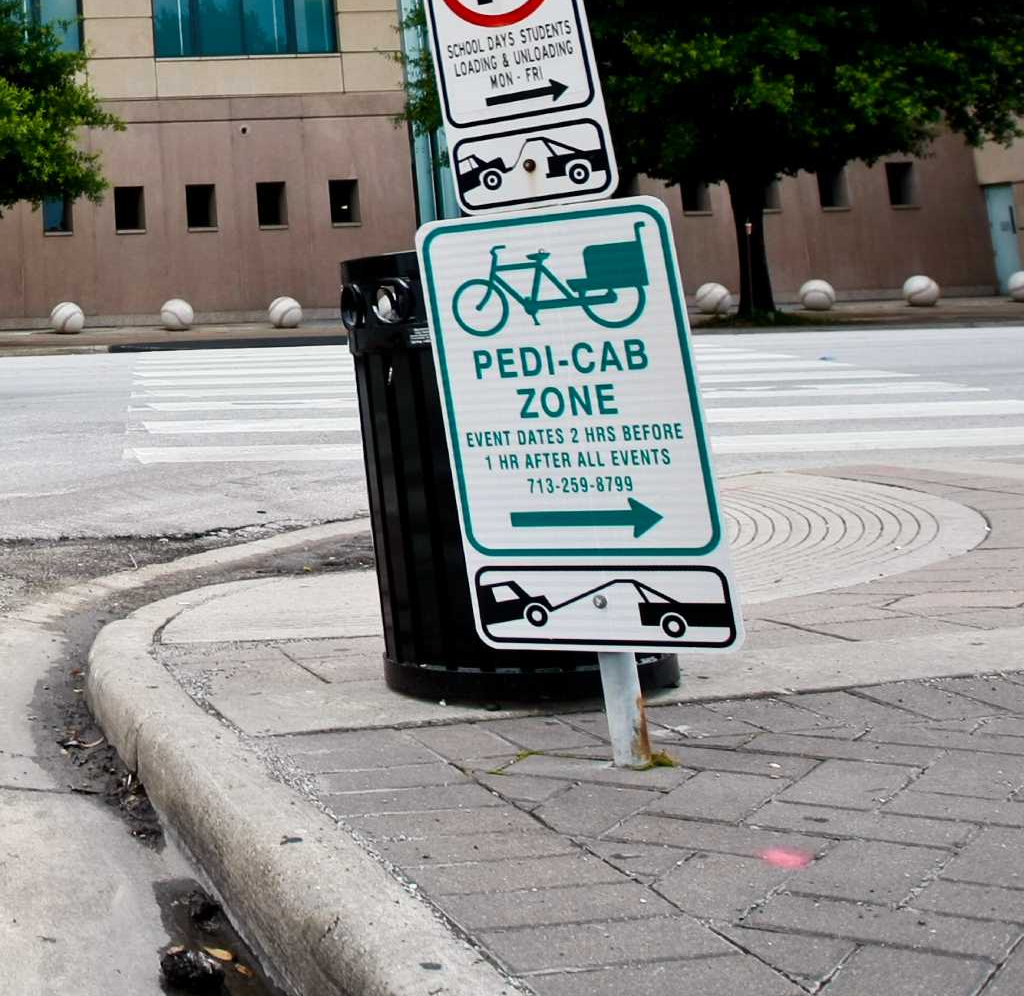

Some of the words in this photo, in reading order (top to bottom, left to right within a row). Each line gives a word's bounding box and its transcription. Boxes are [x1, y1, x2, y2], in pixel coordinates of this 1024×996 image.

[447, 39, 484, 59] SCHOOL
[487, 31, 515, 50] DAYS
[520, 20, 572, 44] STUDENTS
[455, 54, 497, 77] LOADING
[502, 49, 510, 68] &
[514, 40, 574, 65] UNLOADING
[490, 69, 514, 89] MON
[525, 65, 543, 83] FRI
[473, 338, 649, 380] PEDI-CAB
[516, 383, 619, 419] ZONE
[466, 431, 511, 449] EVENT
[517, 428, 564, 446] DATES
[571, 428, 578, 444] 2
[585, 426, 616, 443] HRS
[623, 422, 684, 441] BEFORE
[485, 455, 491, 470] 1
[500, 453, 520, 471] HR
[525, 451, 572, 470] AFTER
[578, 450, 606, 468] ALL
[611, 448, 671, 467] EVENTS
[527, 475, 633, 494] 713-259-8799
